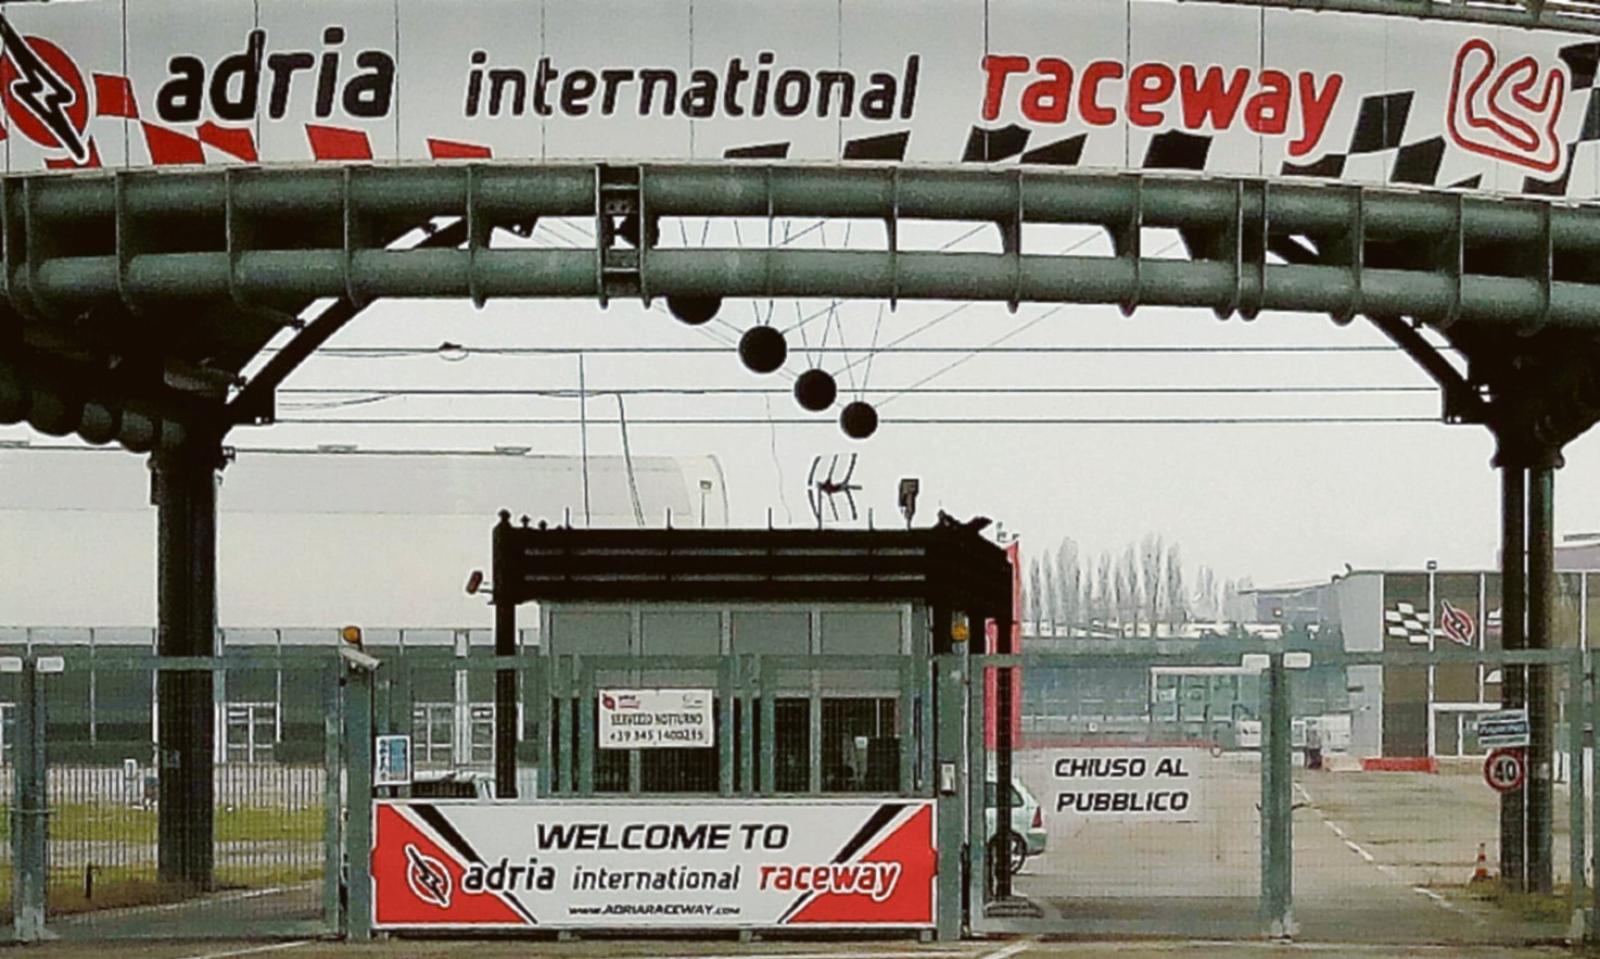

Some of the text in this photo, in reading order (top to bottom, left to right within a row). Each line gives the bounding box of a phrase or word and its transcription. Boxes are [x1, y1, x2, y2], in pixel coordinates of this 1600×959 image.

[155, 28, 1343, 156] adria international raceway
[1054, 758, 1189, 777] CHIUSO AL
[1493, 760, 1517, 782] 40
[1056, 791, 1189, 812] PUBBLICO
[537, 823, 789, 850] WELCOME TO
[464, 857, 900, 899] adria international raceway
